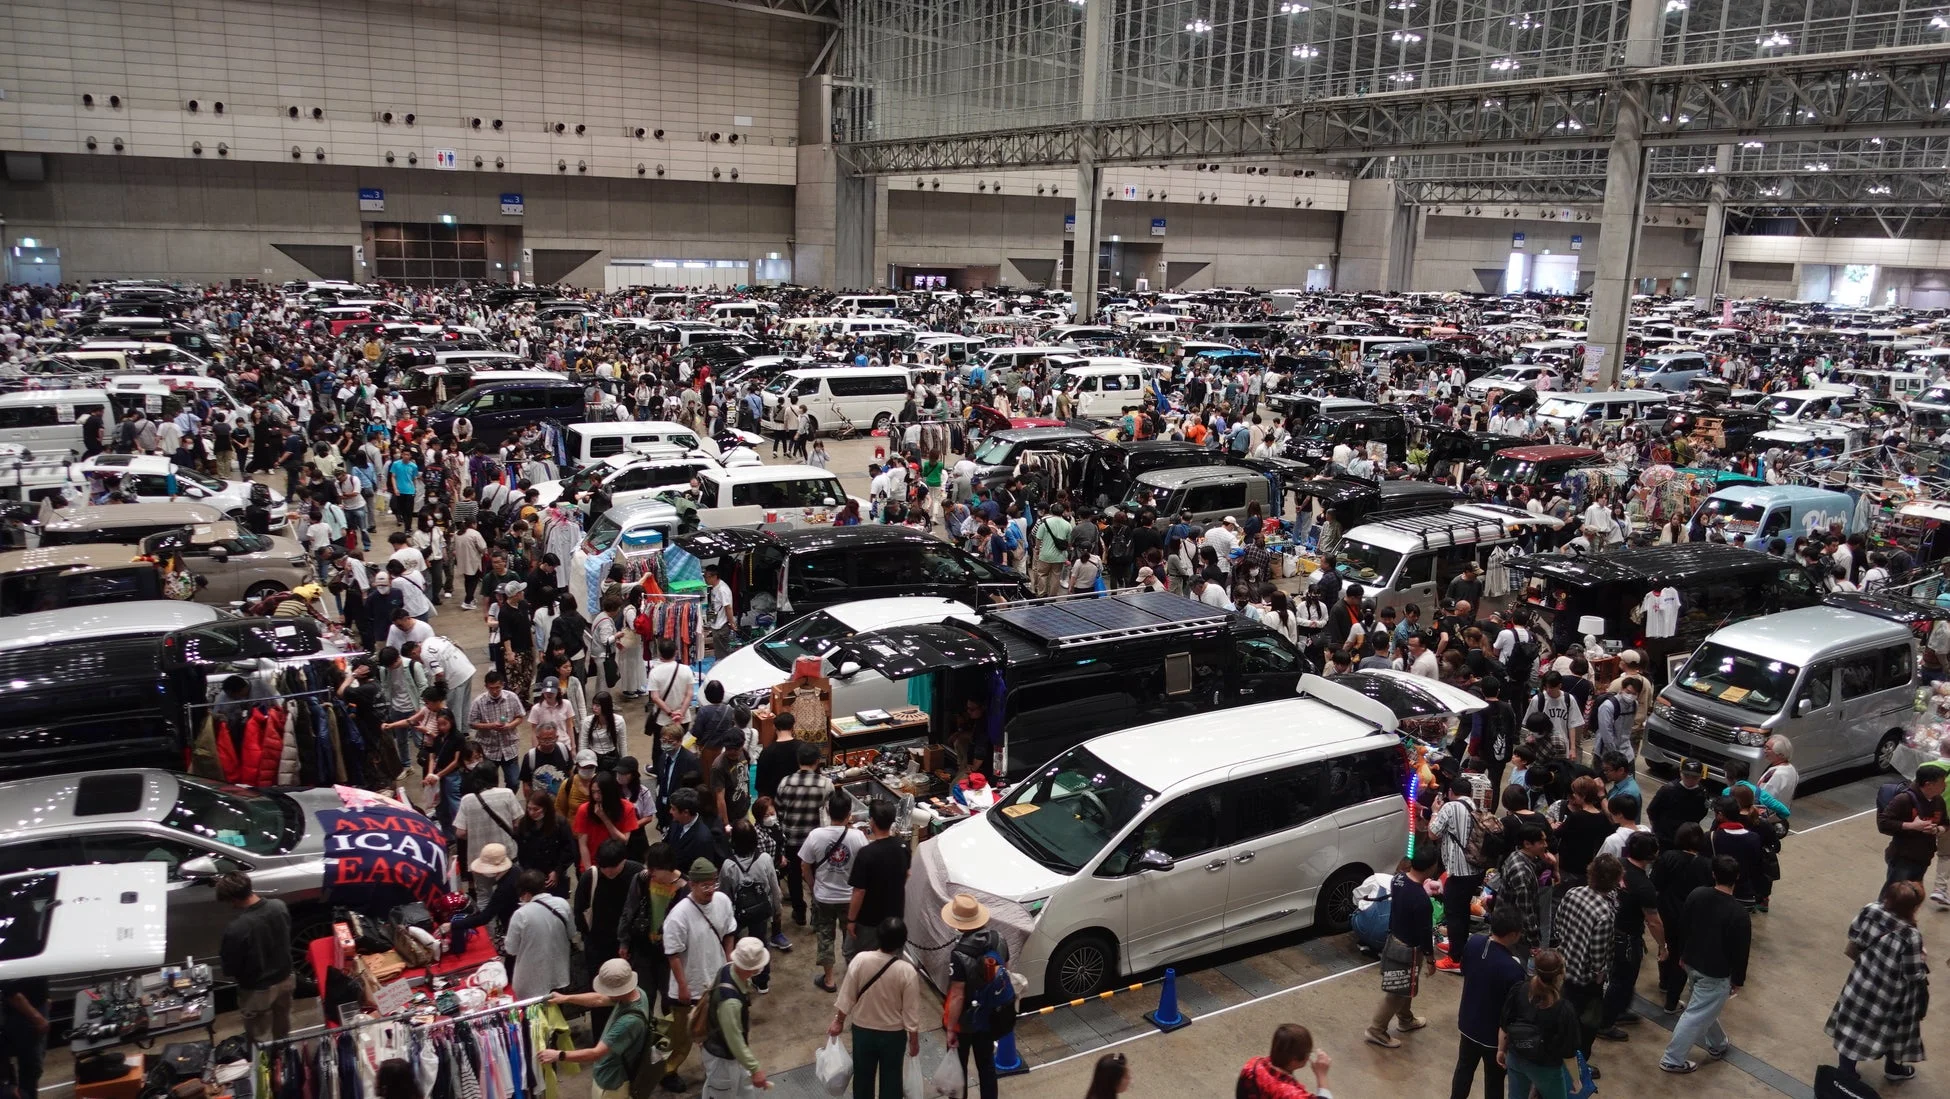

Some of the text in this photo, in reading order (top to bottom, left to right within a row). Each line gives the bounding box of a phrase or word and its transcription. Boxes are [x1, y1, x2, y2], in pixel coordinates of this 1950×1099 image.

[374, 190, 380, 199] 3
[514, 195, 520, 204] 3
[332, 832, 447, 885] ICAN
